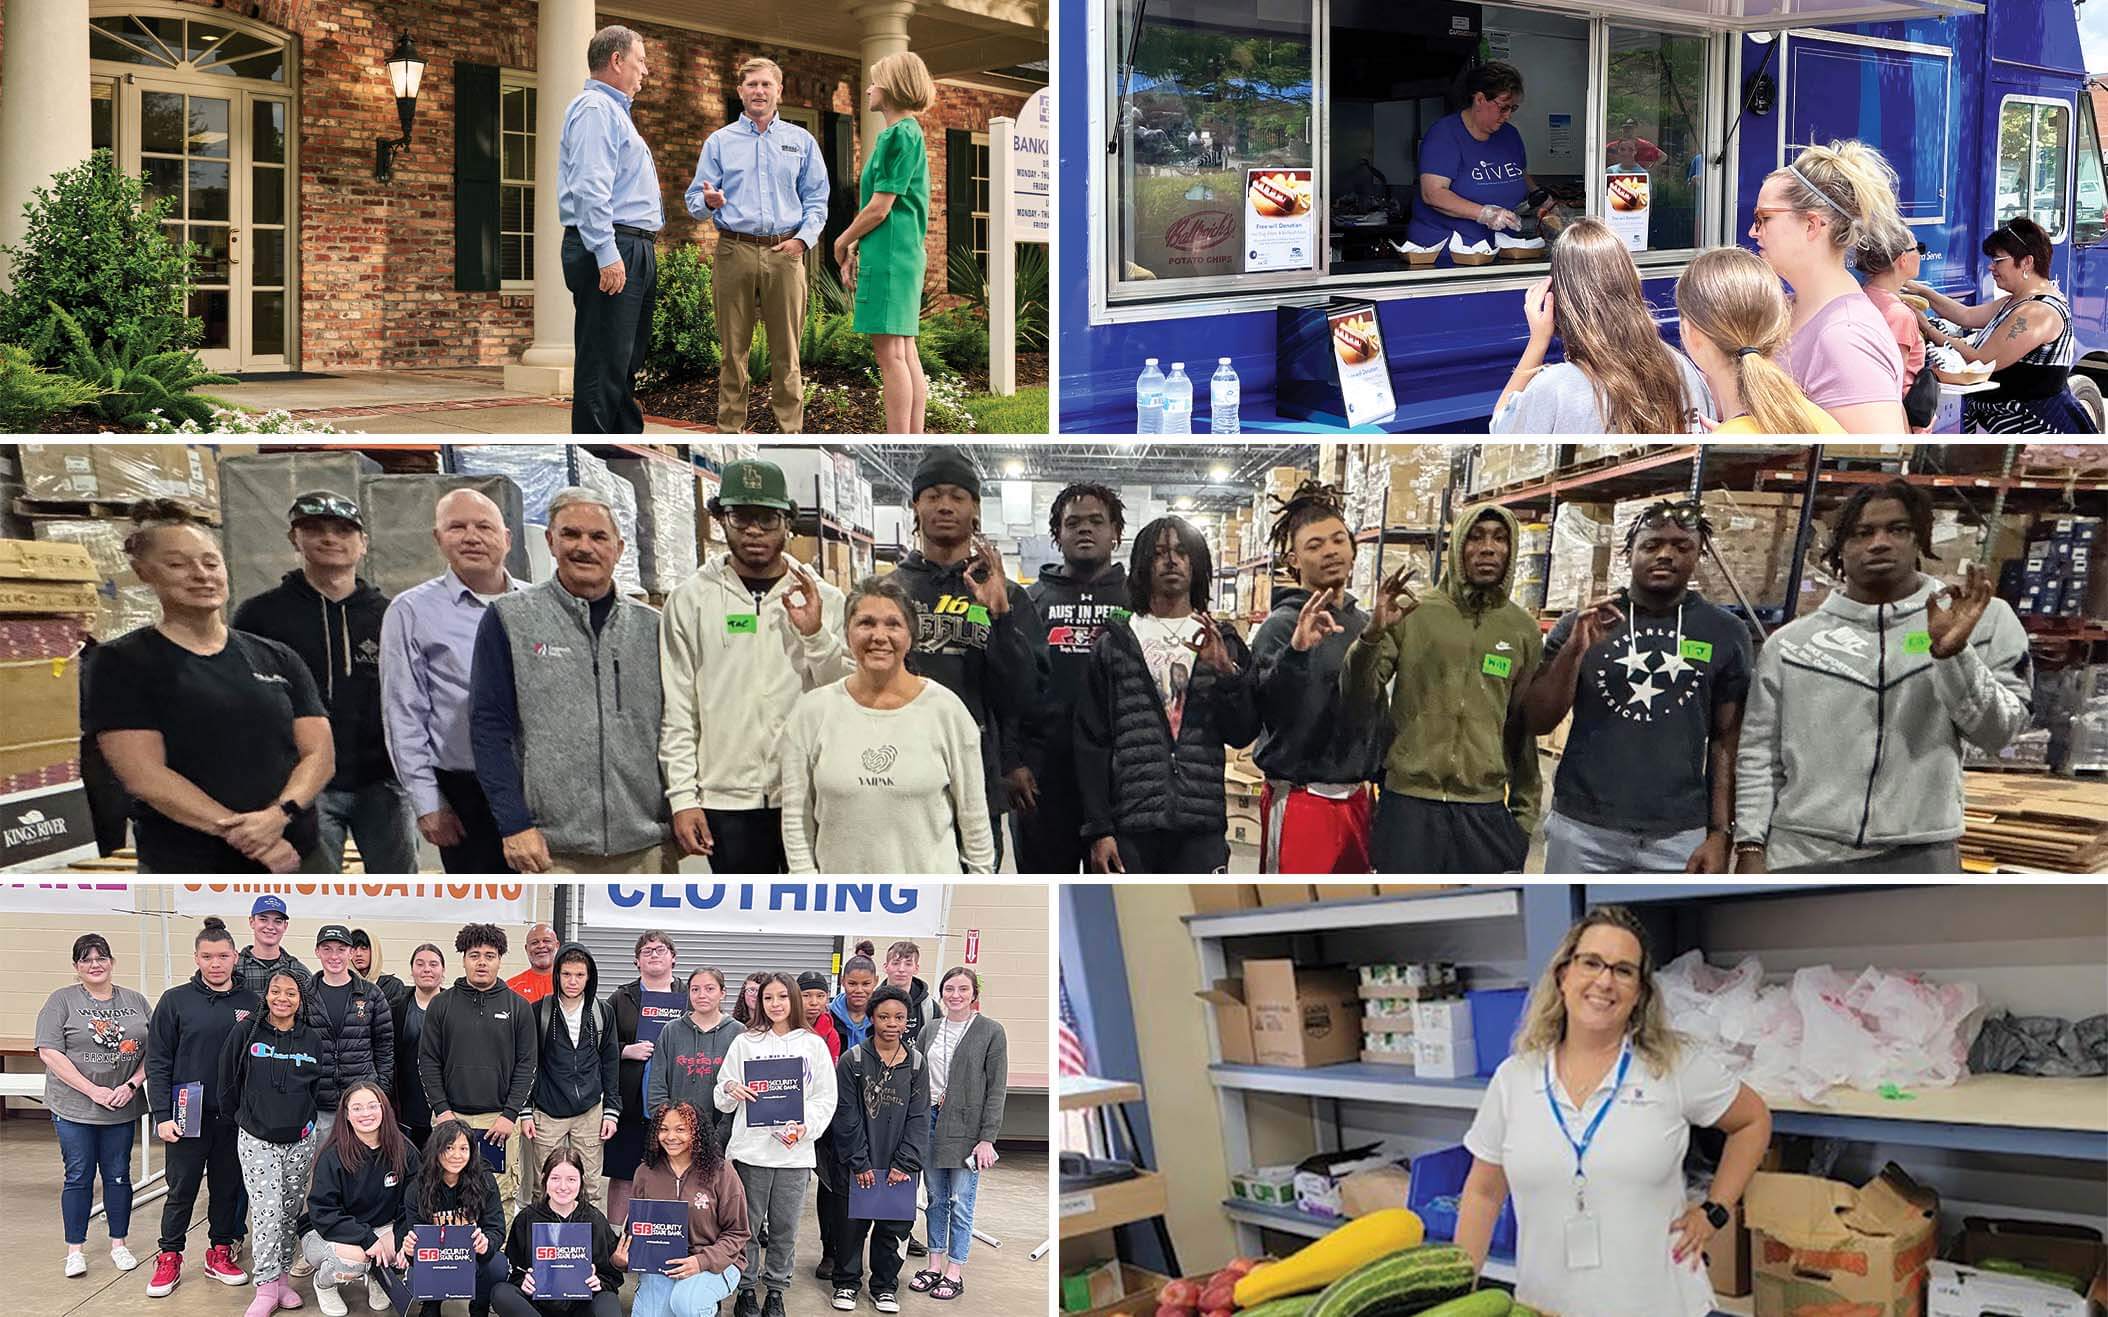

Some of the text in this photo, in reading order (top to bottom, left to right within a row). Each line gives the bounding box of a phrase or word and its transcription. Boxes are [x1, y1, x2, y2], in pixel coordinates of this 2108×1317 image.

[1014, 136, 1048, 154] BANKI
[1017, 169, 1036, 177] MONDAY
[1017, 209, 1036, 217] MONDAY
[1168, 255, 1233, 264] POTATO CHIPS
[933, 594, 969, 614] 16
[1049, 604, 1123, 619] AUSIN PE
[1613, 628, 1687, 648] FEARLES
[1597, 670, 1652, 721] PHYSICAL
[3, 825, 37, 848] KINGS
[37, 817, 68, 837] RIVER
[76, 1008, 139, 1018] WEWOKA
